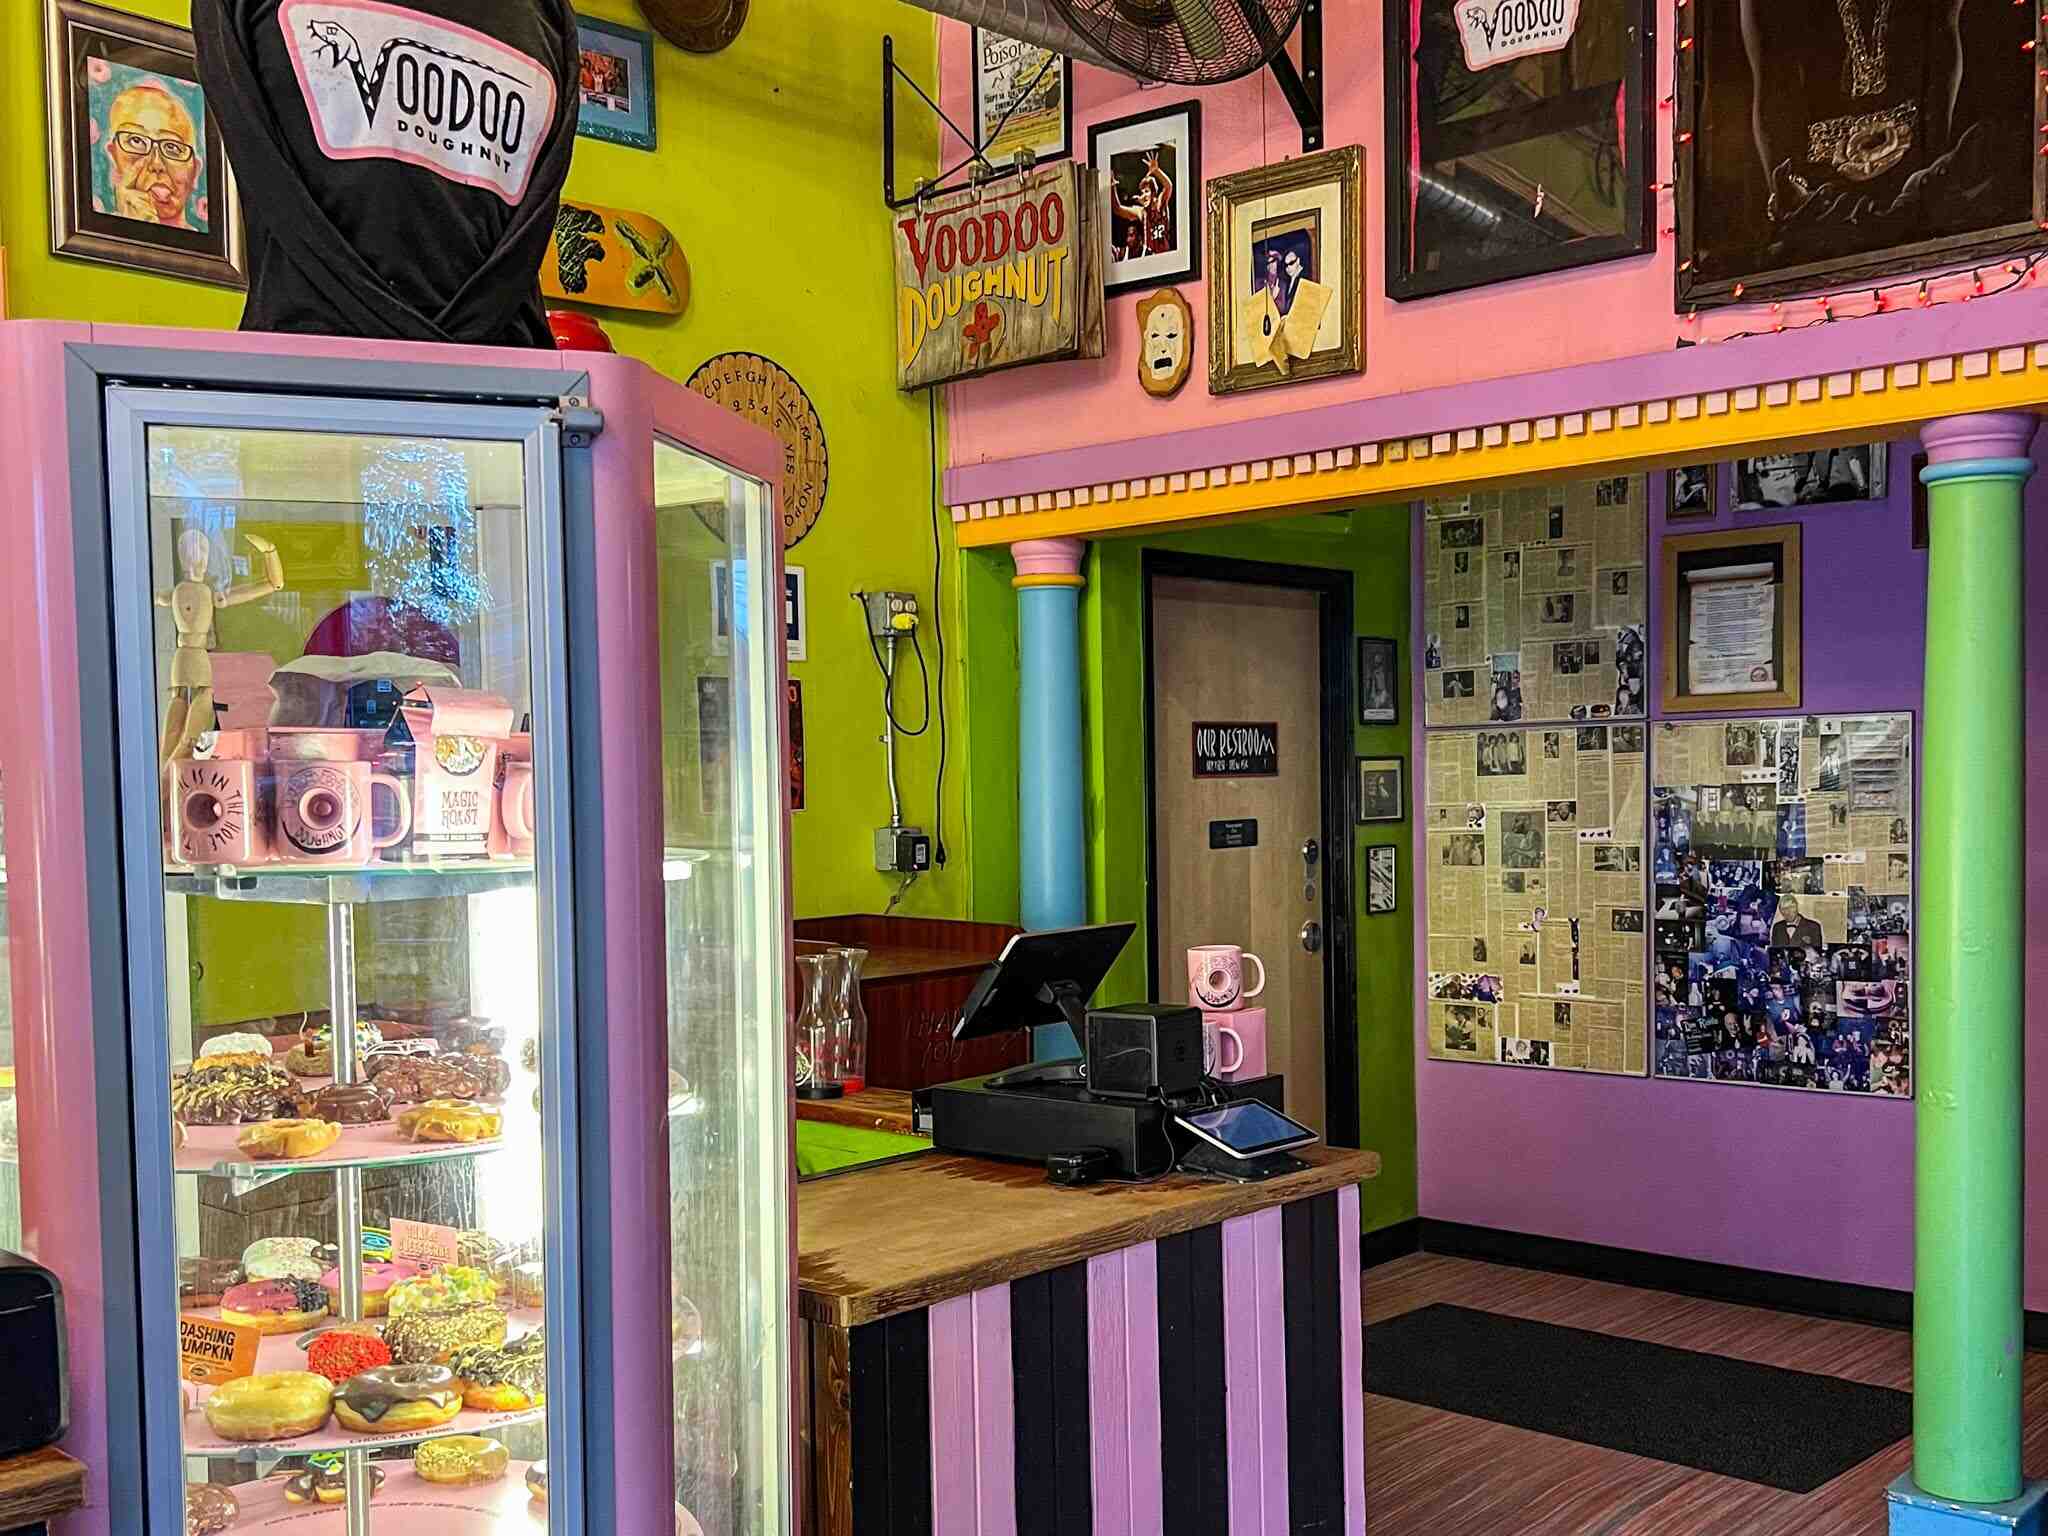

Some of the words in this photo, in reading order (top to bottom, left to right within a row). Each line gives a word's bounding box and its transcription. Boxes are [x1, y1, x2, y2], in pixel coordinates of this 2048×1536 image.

[1484, 0, 1565, 51] VOODOO
[1501, 27, 1563, 47] DOUGHNUT
[347, 38, 526, 154] VOODOO
[398, 119, 511, 174] DOUGHNUT
[898, 191, 1064, 287] VOODOO
[902, 247, 1068, 369] DOUGHNUT
[783, 443, 795, 475] YES
[1197, 727, 1217, 758] OUR
[1219, 727, 1275, 758] RESTROOM
[211, 771, 230, 791] IN
[441, 791, 478, 808] MAGIC
[441, 808, 478, 828] ROAST
[181, 1320, 236, 1345] DASHING
[181, 1337, 234, 1361] UMPKIN
